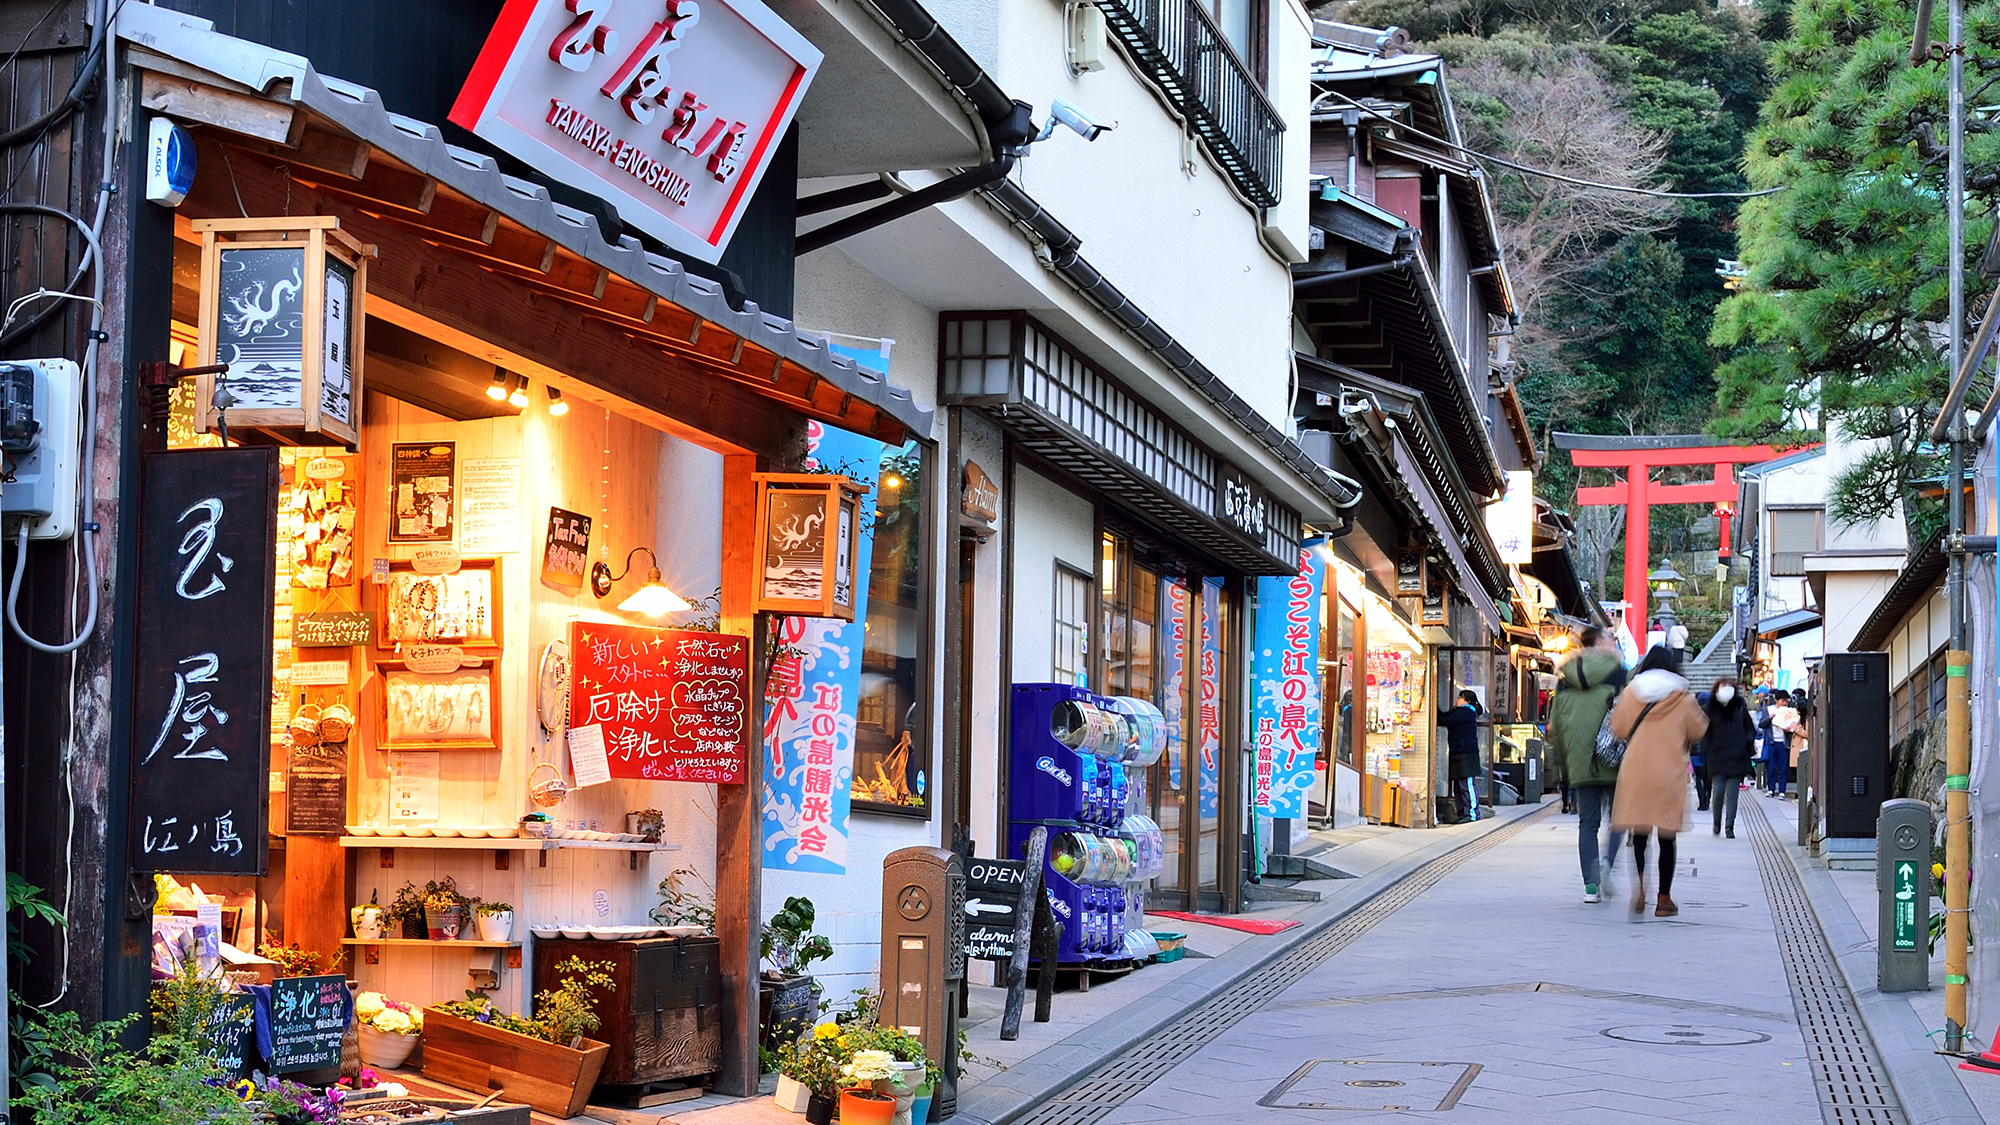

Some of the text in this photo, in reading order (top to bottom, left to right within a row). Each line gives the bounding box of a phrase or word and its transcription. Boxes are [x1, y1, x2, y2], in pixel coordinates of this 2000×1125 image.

[155, 146, 163, 178] ALSOK
[546, 98, 693, 207] TAMAYA-ENOSHIMA
[141, 497, 234, 767] 玉屋
[590, 637, 649, 667] 新しい
[676, 639, 732, 660] 天然石で
[684, 687, 730, 703] 水晶チップ
[1493, 660, 1508, 709] 海鮮料理
[584, 690, 666, 725] 厄除け
[703, 700, 735, 713] にぎり石
[694, 738, 735, 755] 店内多数
[697, 727, 734, 737] などなど
[1256, 718, 1274, 806] 江の島観光会
[143, 808, 243, 858] 江ノ島
[970, 864, 1026, 885] OPEN
[278, 990, 317, 1022] 浄化
